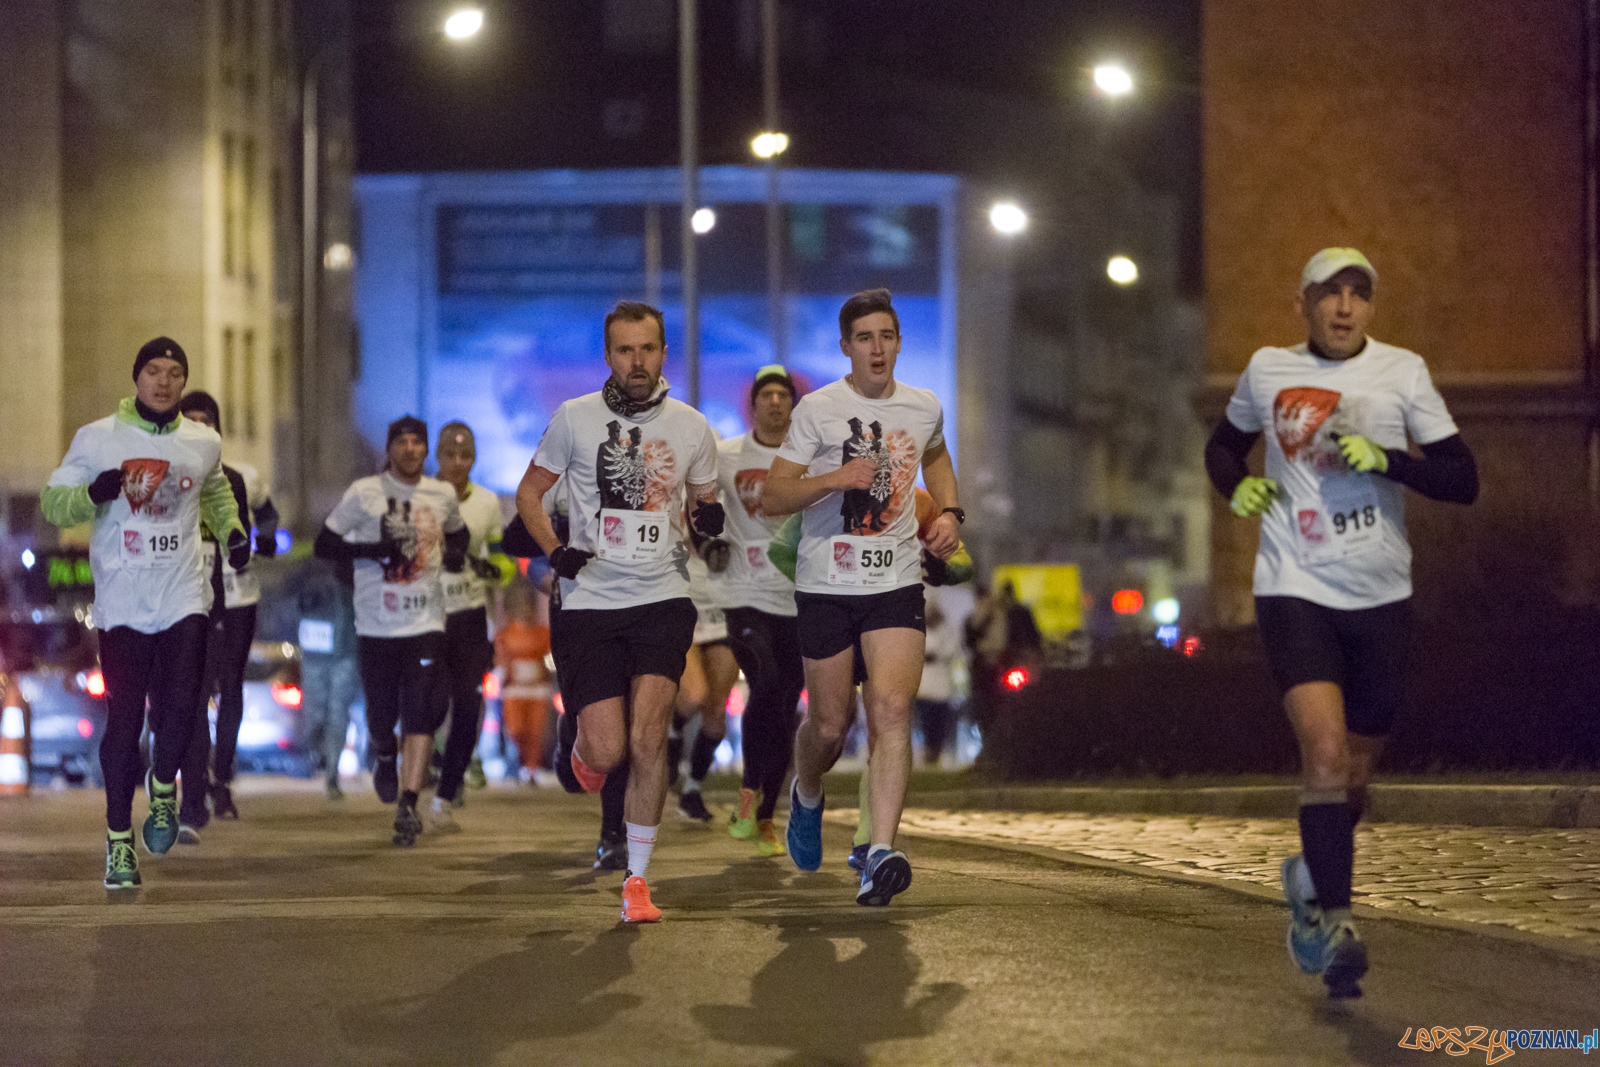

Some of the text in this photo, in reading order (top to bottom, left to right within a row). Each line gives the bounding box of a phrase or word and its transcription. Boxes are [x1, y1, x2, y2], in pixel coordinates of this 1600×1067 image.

[1333, 505, 1375, 534] 918
[149, 535, 179, 551] 195
[637, 524, 660, 543] 19
[861, 549, 894, 568] 530
[403, 594, 427, 610] 219
